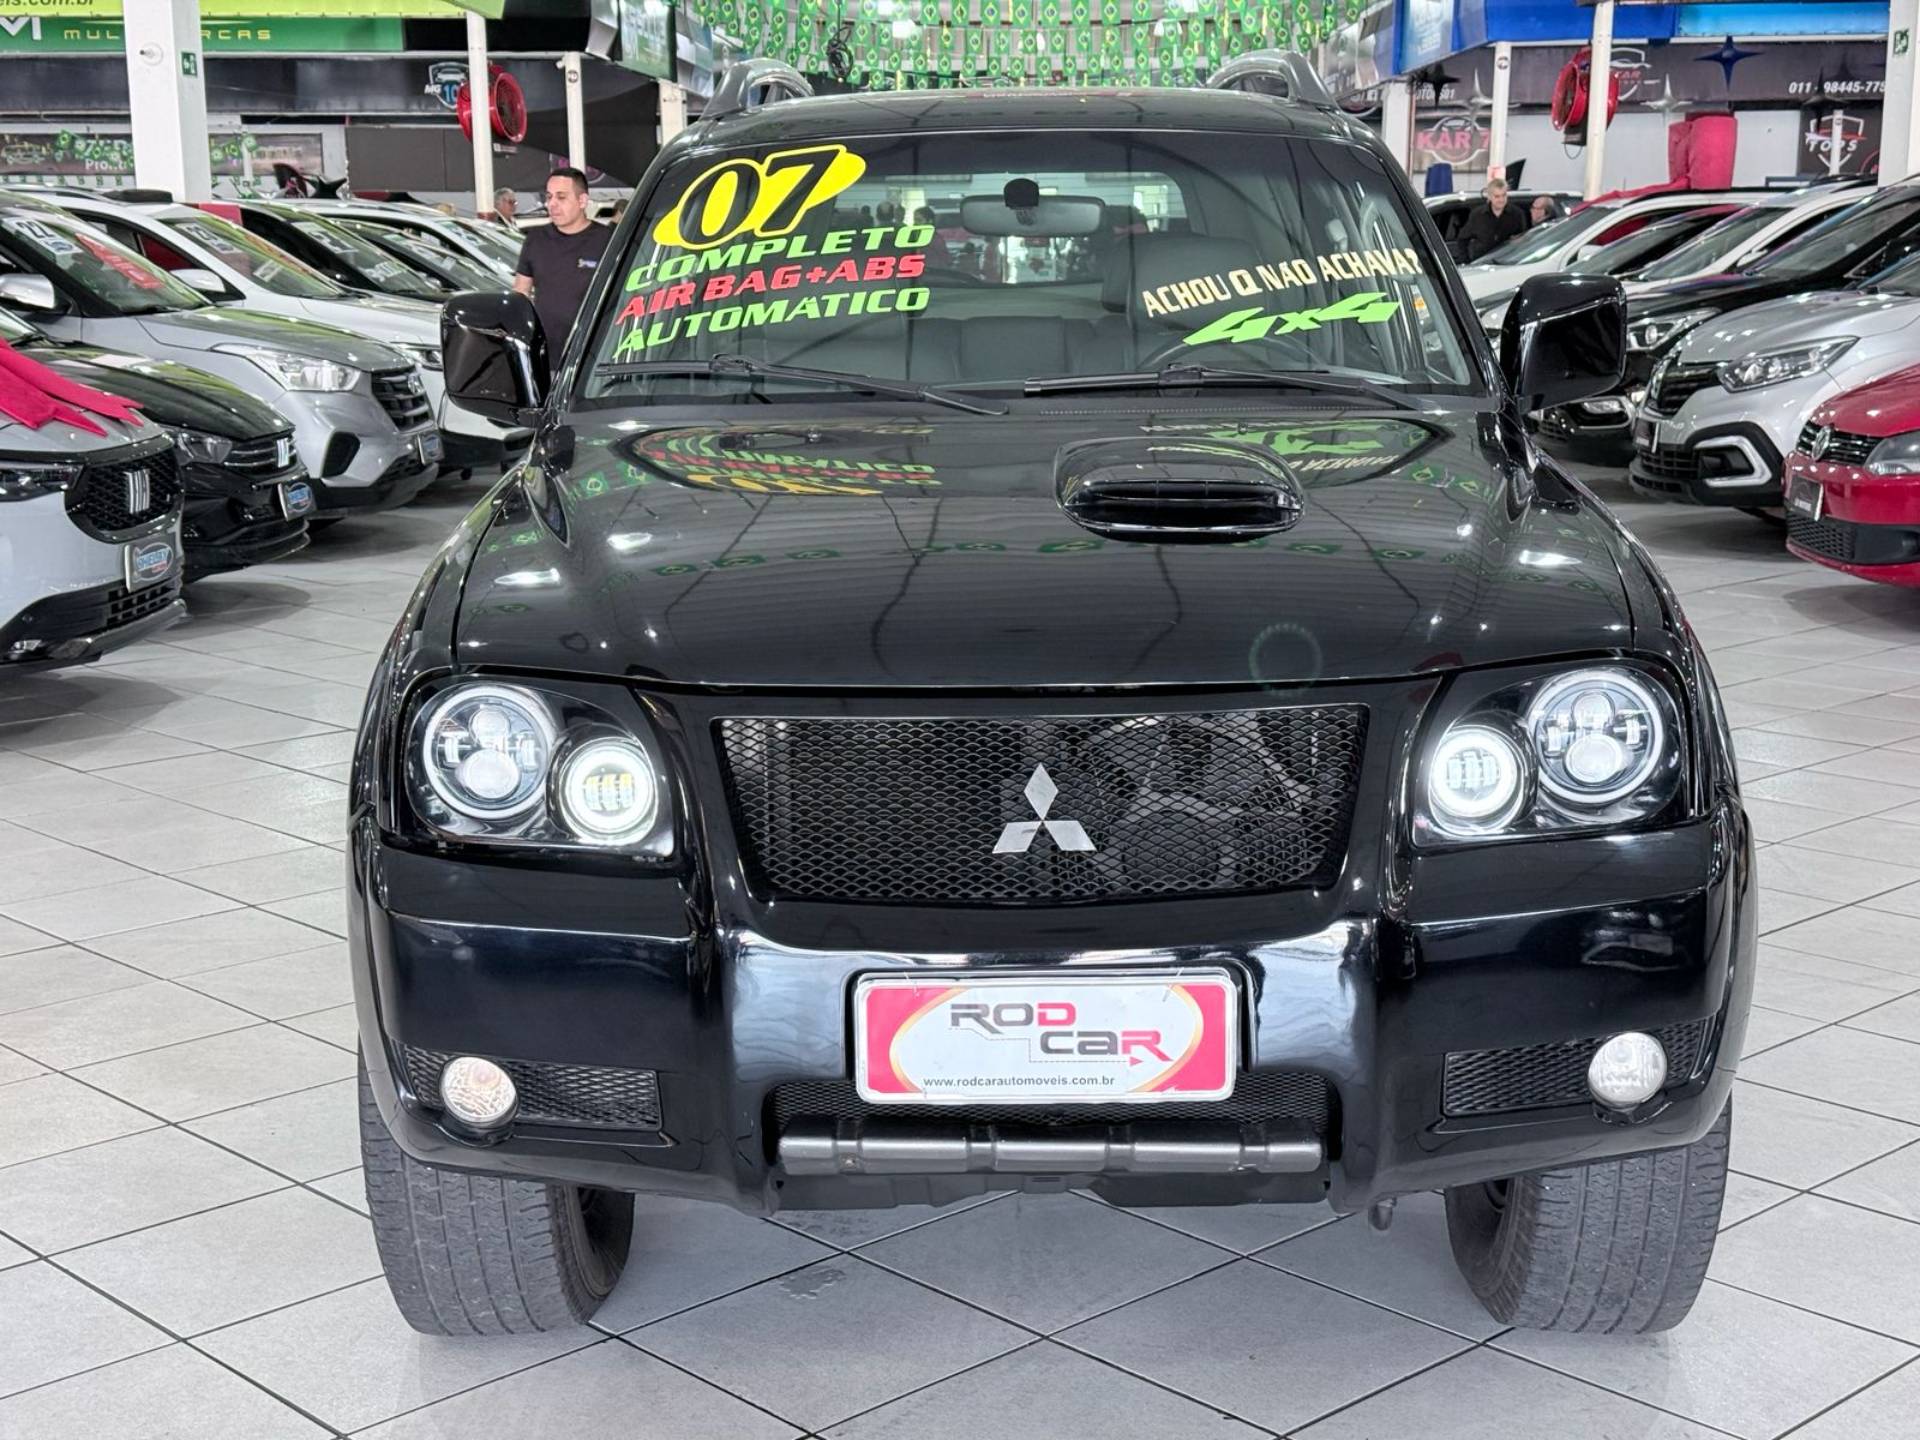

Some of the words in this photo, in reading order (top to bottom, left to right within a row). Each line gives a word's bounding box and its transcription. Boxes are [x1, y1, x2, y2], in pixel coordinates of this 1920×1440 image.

[1788, 81, 1812, 94] 011
[1417, 130, 1472, 150] KAR
[672, 144, 847, 250] 07
[625, 225, 935, 292] COMPLETO
[615, 281, 696, 325] AIR
[703, 254, 925, 301] BAG+ABS
[1142, 274, 1231, 318] ACHOU
[1228, 269, 1263, 296] Q
[612, 287, 931, 359] AUTOMÁTICO
[1183, 291, 1400, 346] 4x4
[950, 1003, 1077, 1034] ROD
[922, 1075, 1115, 1088] www.rodcarautomoveis.com.br
